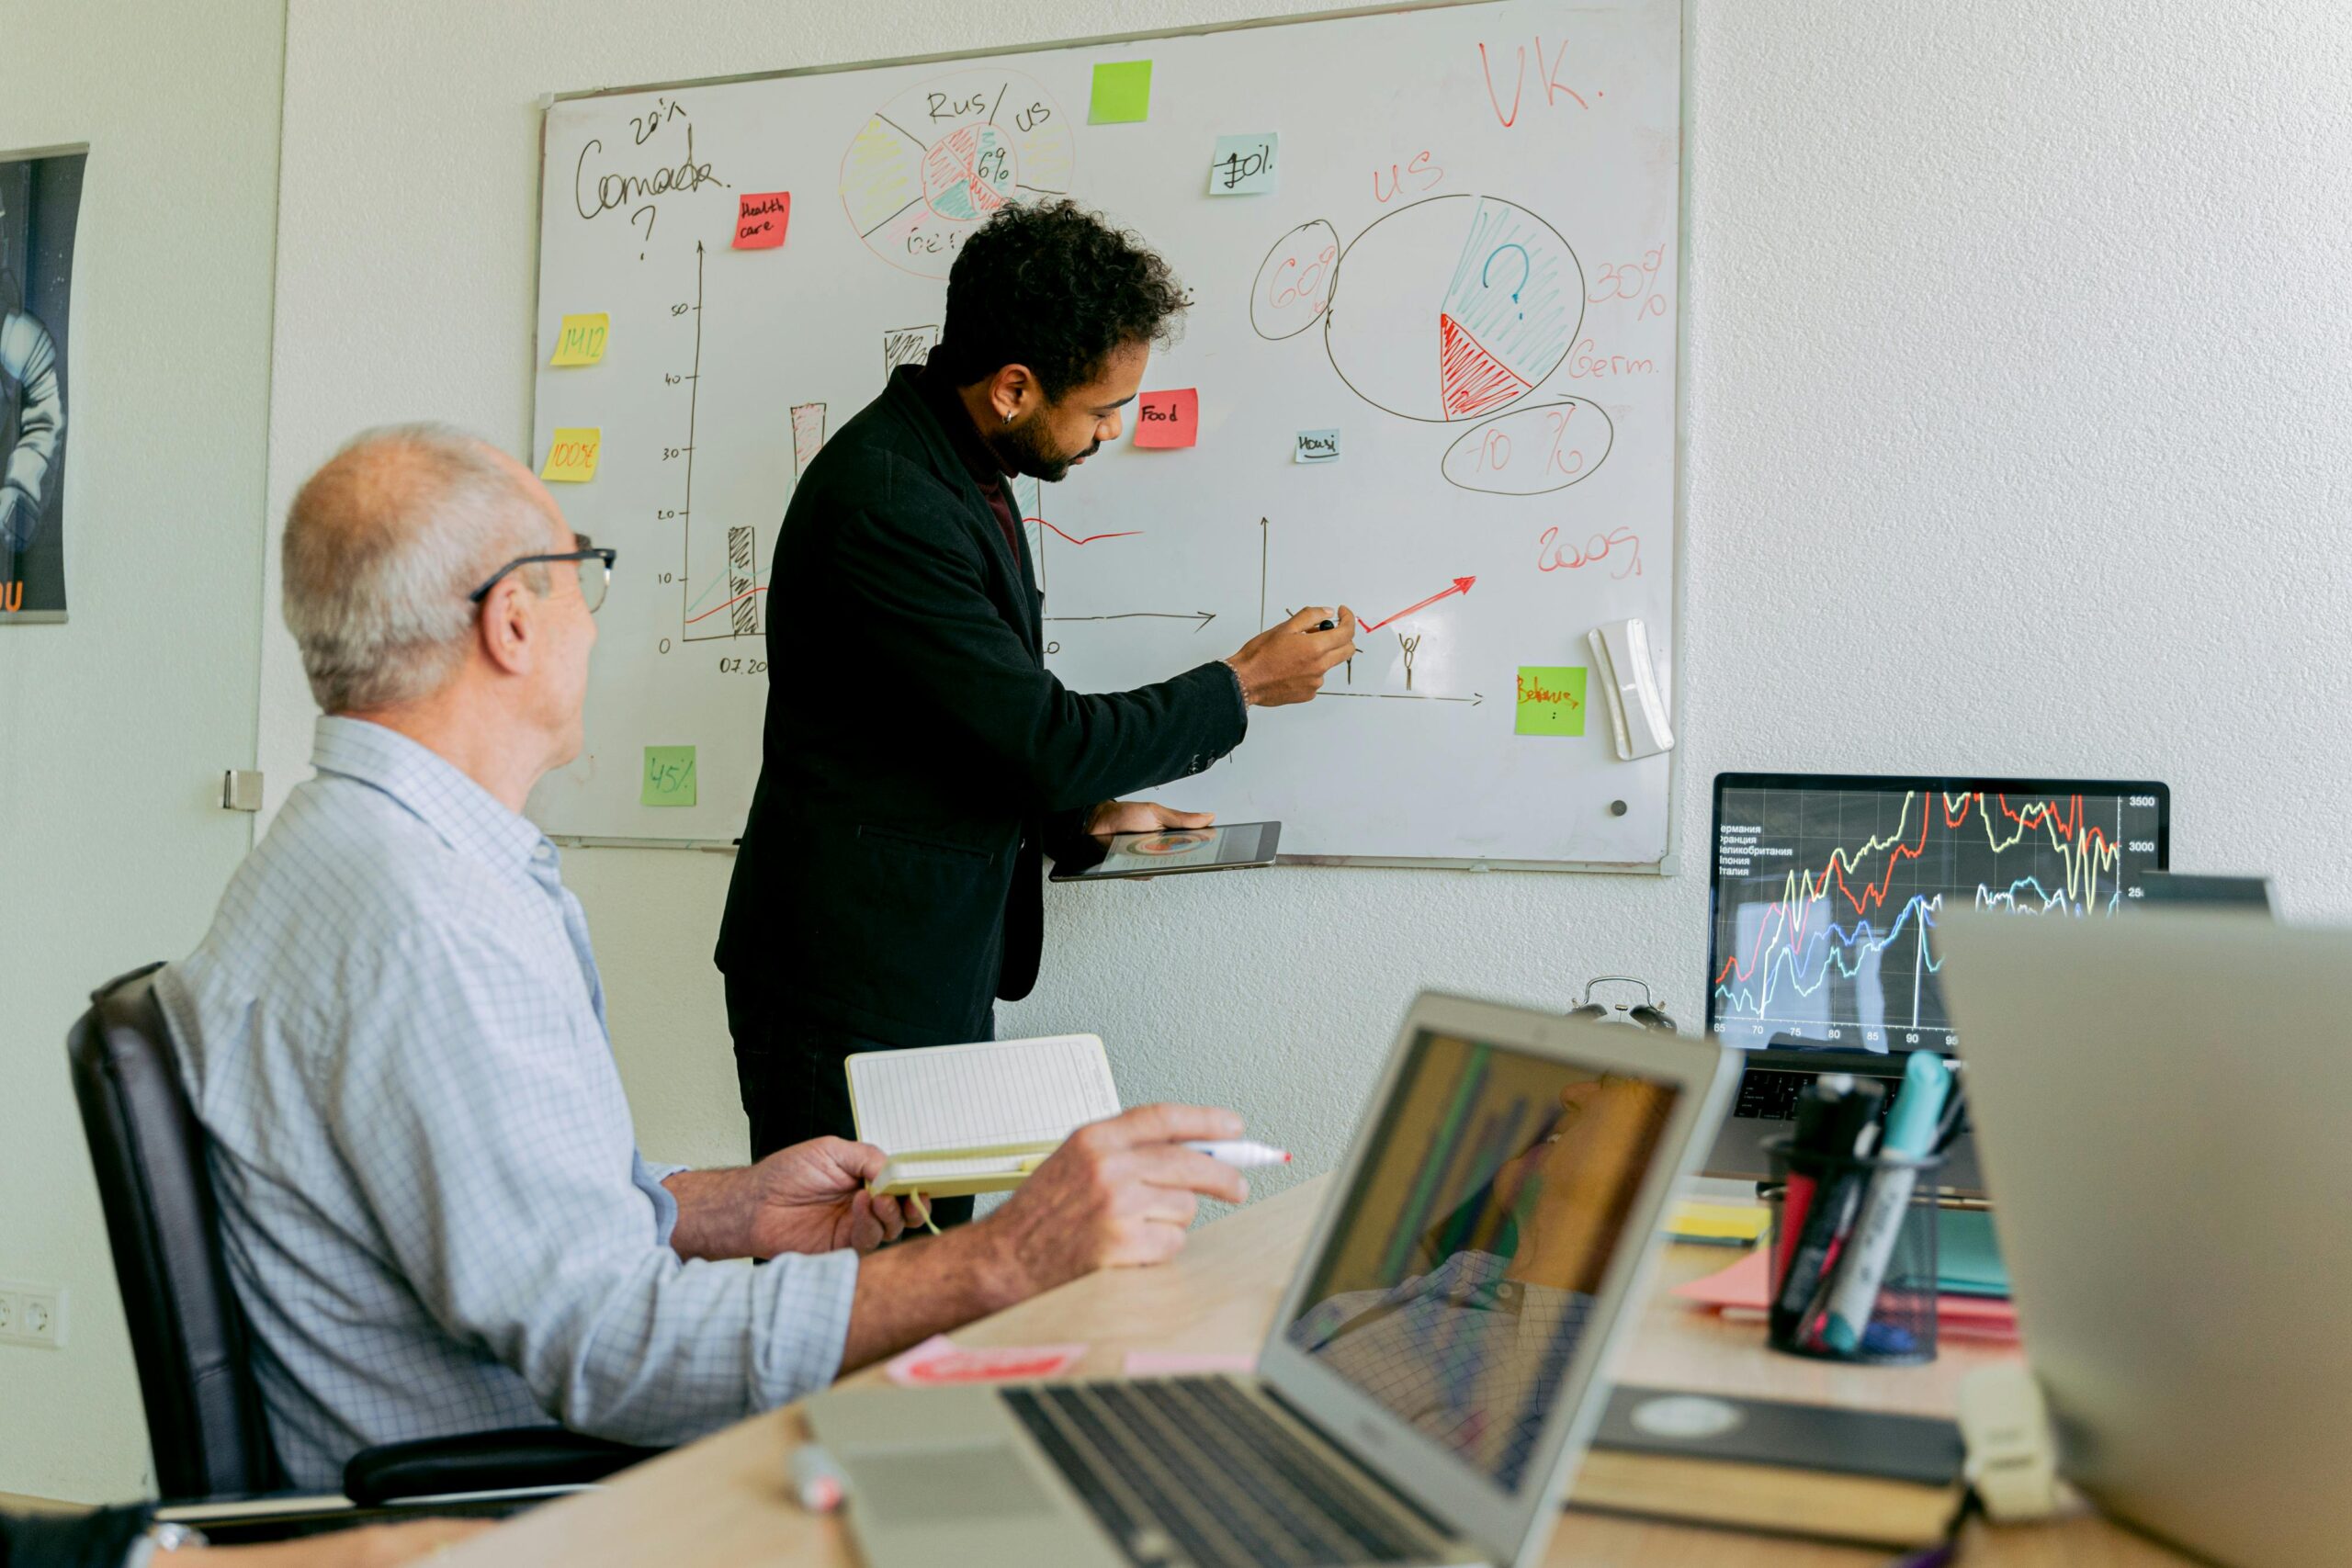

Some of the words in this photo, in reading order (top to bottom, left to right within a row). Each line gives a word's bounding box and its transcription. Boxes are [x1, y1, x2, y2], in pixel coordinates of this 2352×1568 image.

[978, 147, 1010, 184] 6%
[741, 197, 786, 220] Health
[740, 220, 775, 239] care
[1269, 244, 1336, 320] 60%
[1587, 243, 1667, 321] 30%
[671, 302, 689, 317] 50
[664, 372, 682, 387] 40
[1141, 403, 1179, 423] Food
[662, 447, 680, 462] 30
[657, 509, 675, 521] 20
[657, 571, 673, 584] 10
[0, 581, 23, 613] U
[659, 637, 672, 655] 0
[650, 757, 695, 794] 45%
[2129, 796, 2155, 807] 3500
[1720, 824, 1761, 834] ермания
[2128, 841, 2154, 852] 3000
[1713, 1022, 1726, 1033] 65
[1751, 1025, 1764, 1035] 70
[1789, 1027, 1802, 1037] 75
[1827, 1029, 1841, 1040] 80
[1866, 1031, 1880, 1042] 85
[1905, 1033, 1919, 1044] 90
[1945, 1035, 1959, 1046] 95
